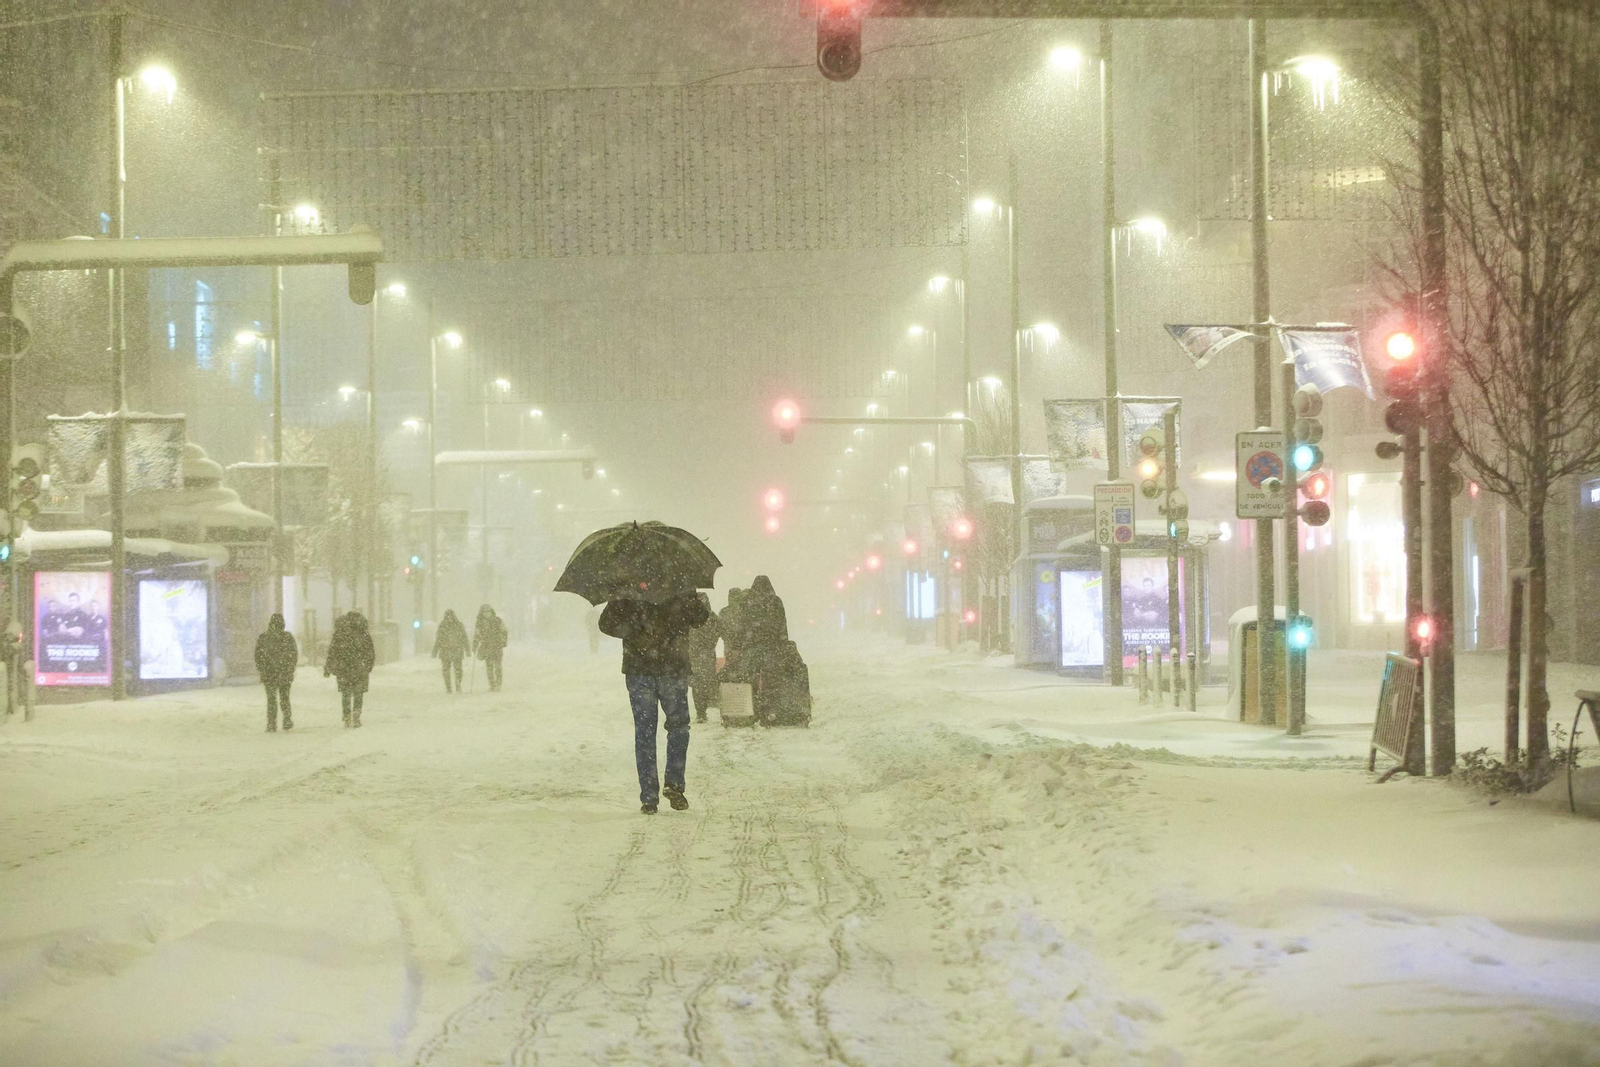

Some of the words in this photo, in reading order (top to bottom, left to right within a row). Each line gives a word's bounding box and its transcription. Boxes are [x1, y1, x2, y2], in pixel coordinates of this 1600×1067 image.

[1241, 441, 1254, 449] EN
[1258, 441, 1282, 449] ACER
[1252, 502, 1284, 510] VEHÍCULO
[1123, 632, 1140, 640] THE
[47, 648, 65, 657] THE
